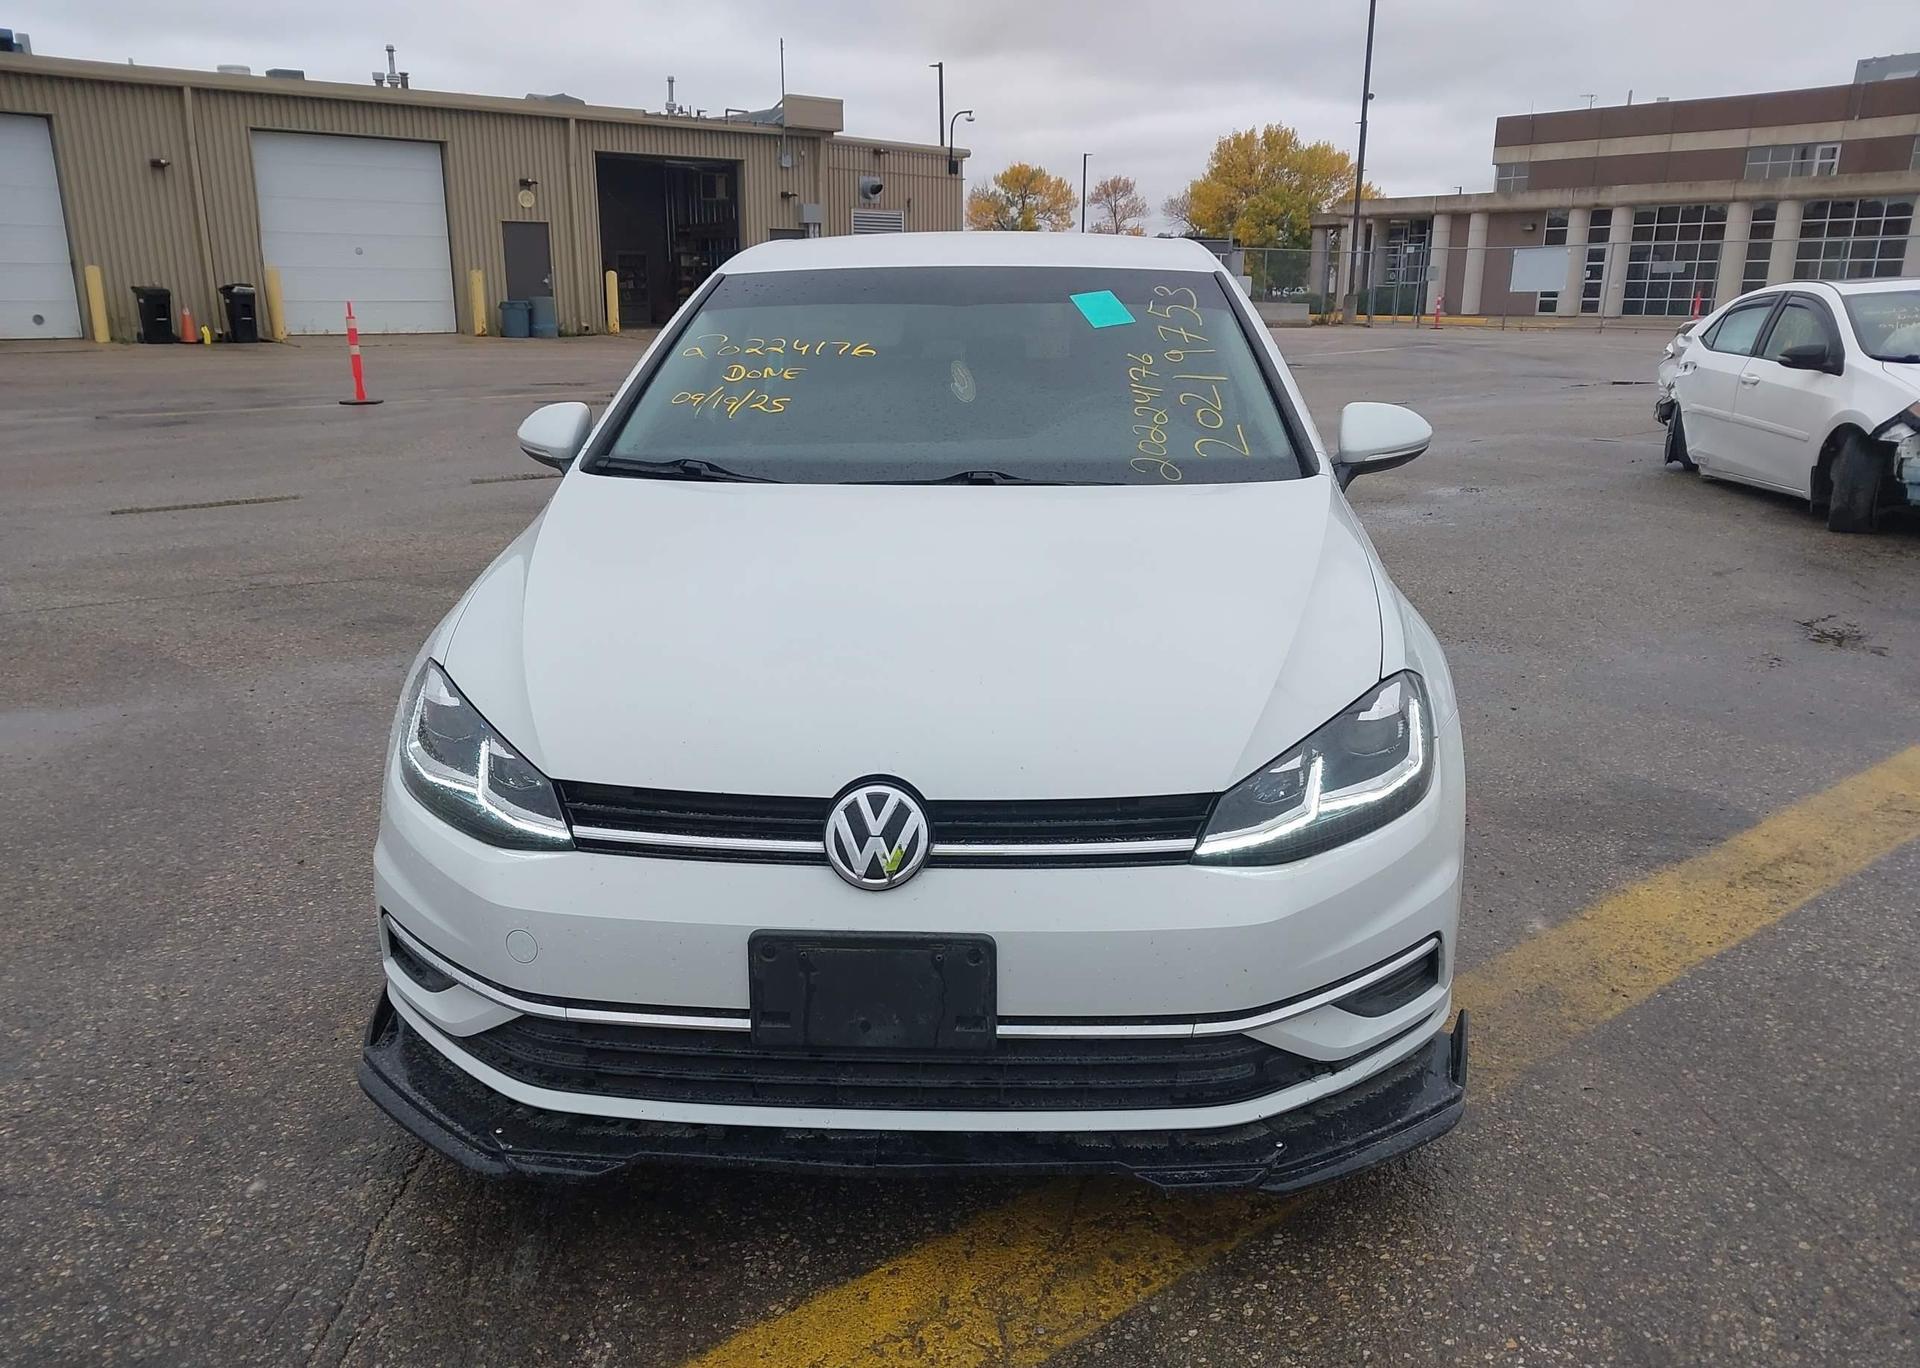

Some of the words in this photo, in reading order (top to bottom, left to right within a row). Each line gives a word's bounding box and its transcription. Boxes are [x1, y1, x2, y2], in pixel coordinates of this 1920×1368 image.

[682, 334, 877, 360] 20224176
[722, 364, 808, 382] DONE
[671, 386, 792, 419] 09/19/25
[831, 788, 921, 881] VW
